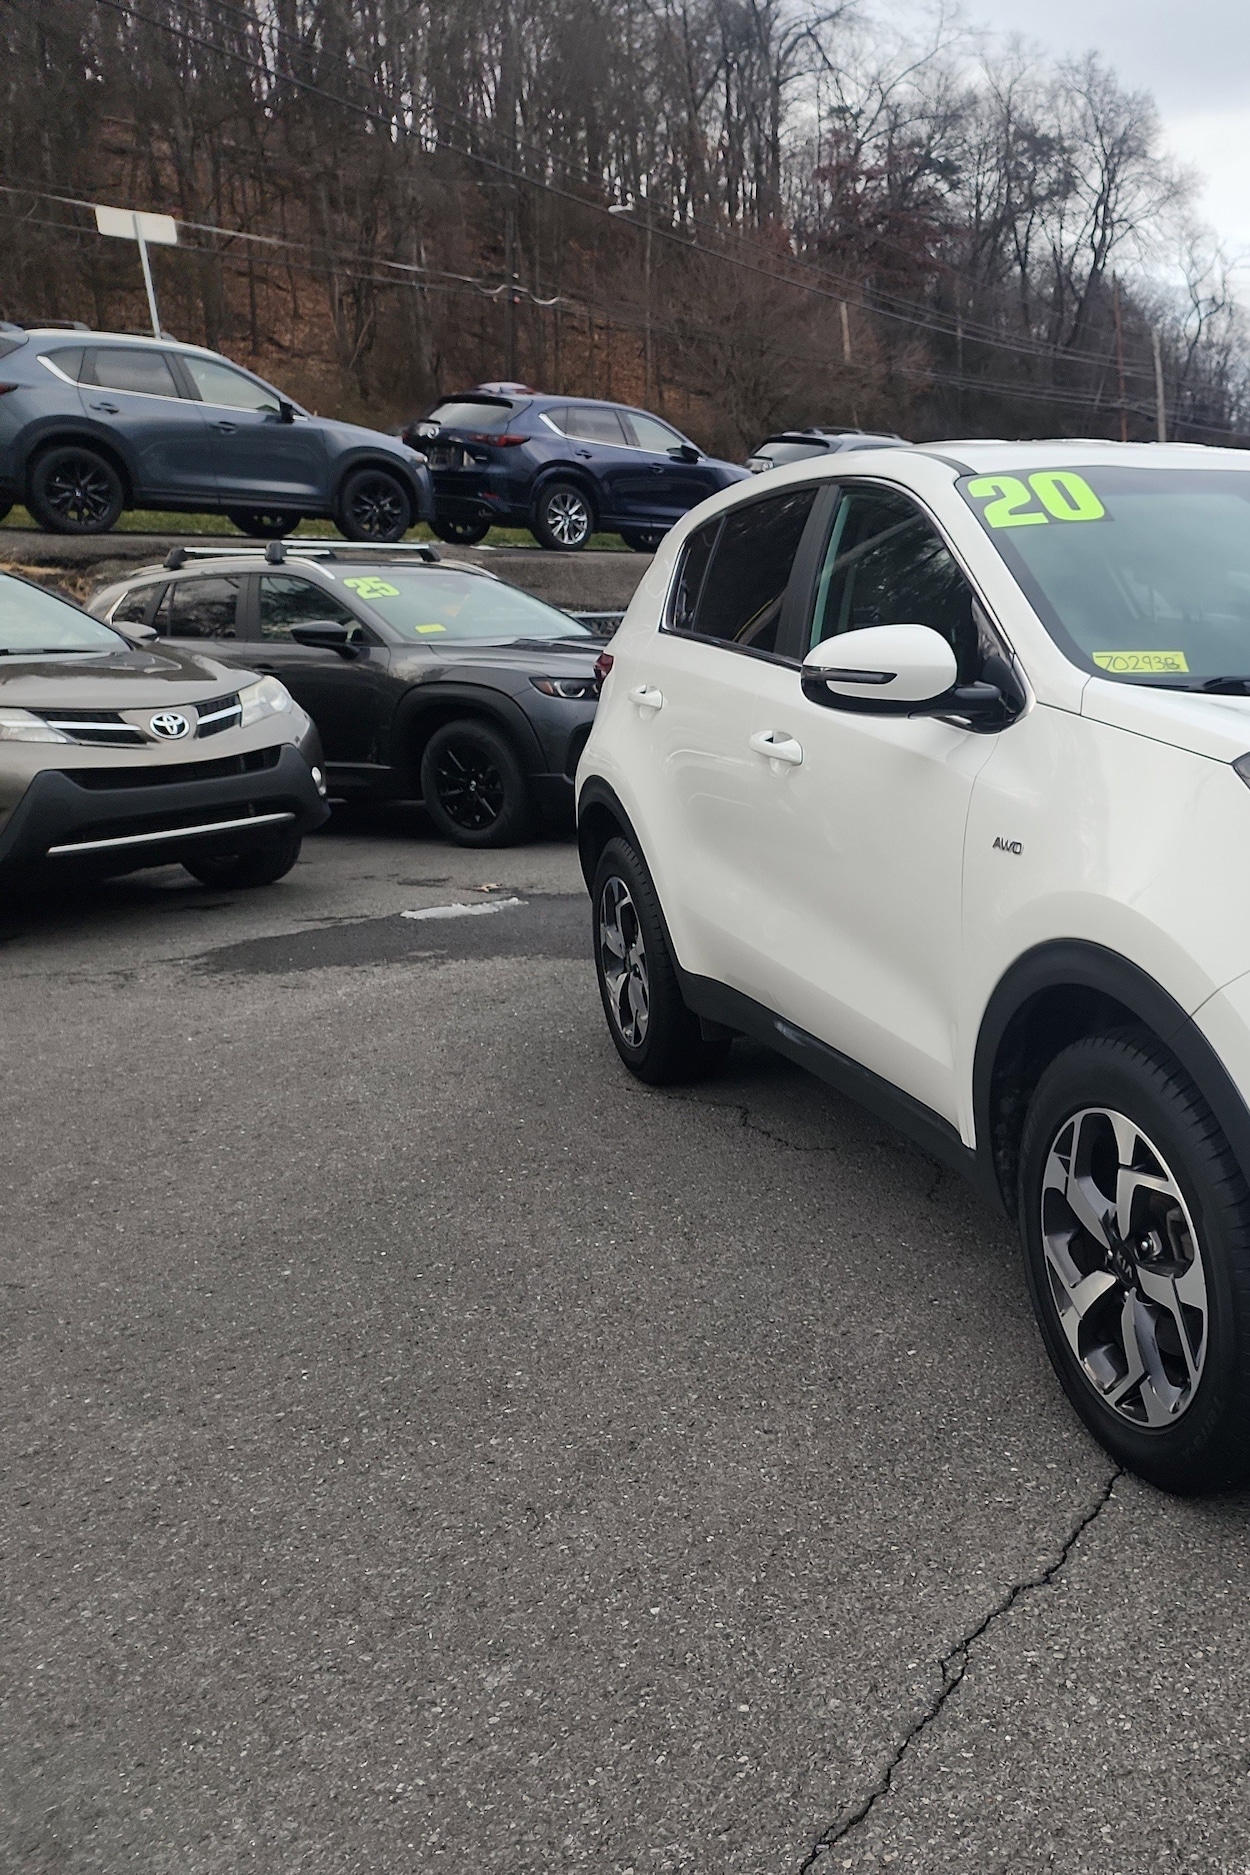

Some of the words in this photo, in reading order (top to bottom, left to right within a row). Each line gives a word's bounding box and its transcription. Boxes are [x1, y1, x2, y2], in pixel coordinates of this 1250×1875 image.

[967, 471, 1105, 528] 20
[343, 576, 400, 600] 25
[992, 837, 1023, 855] AWD
